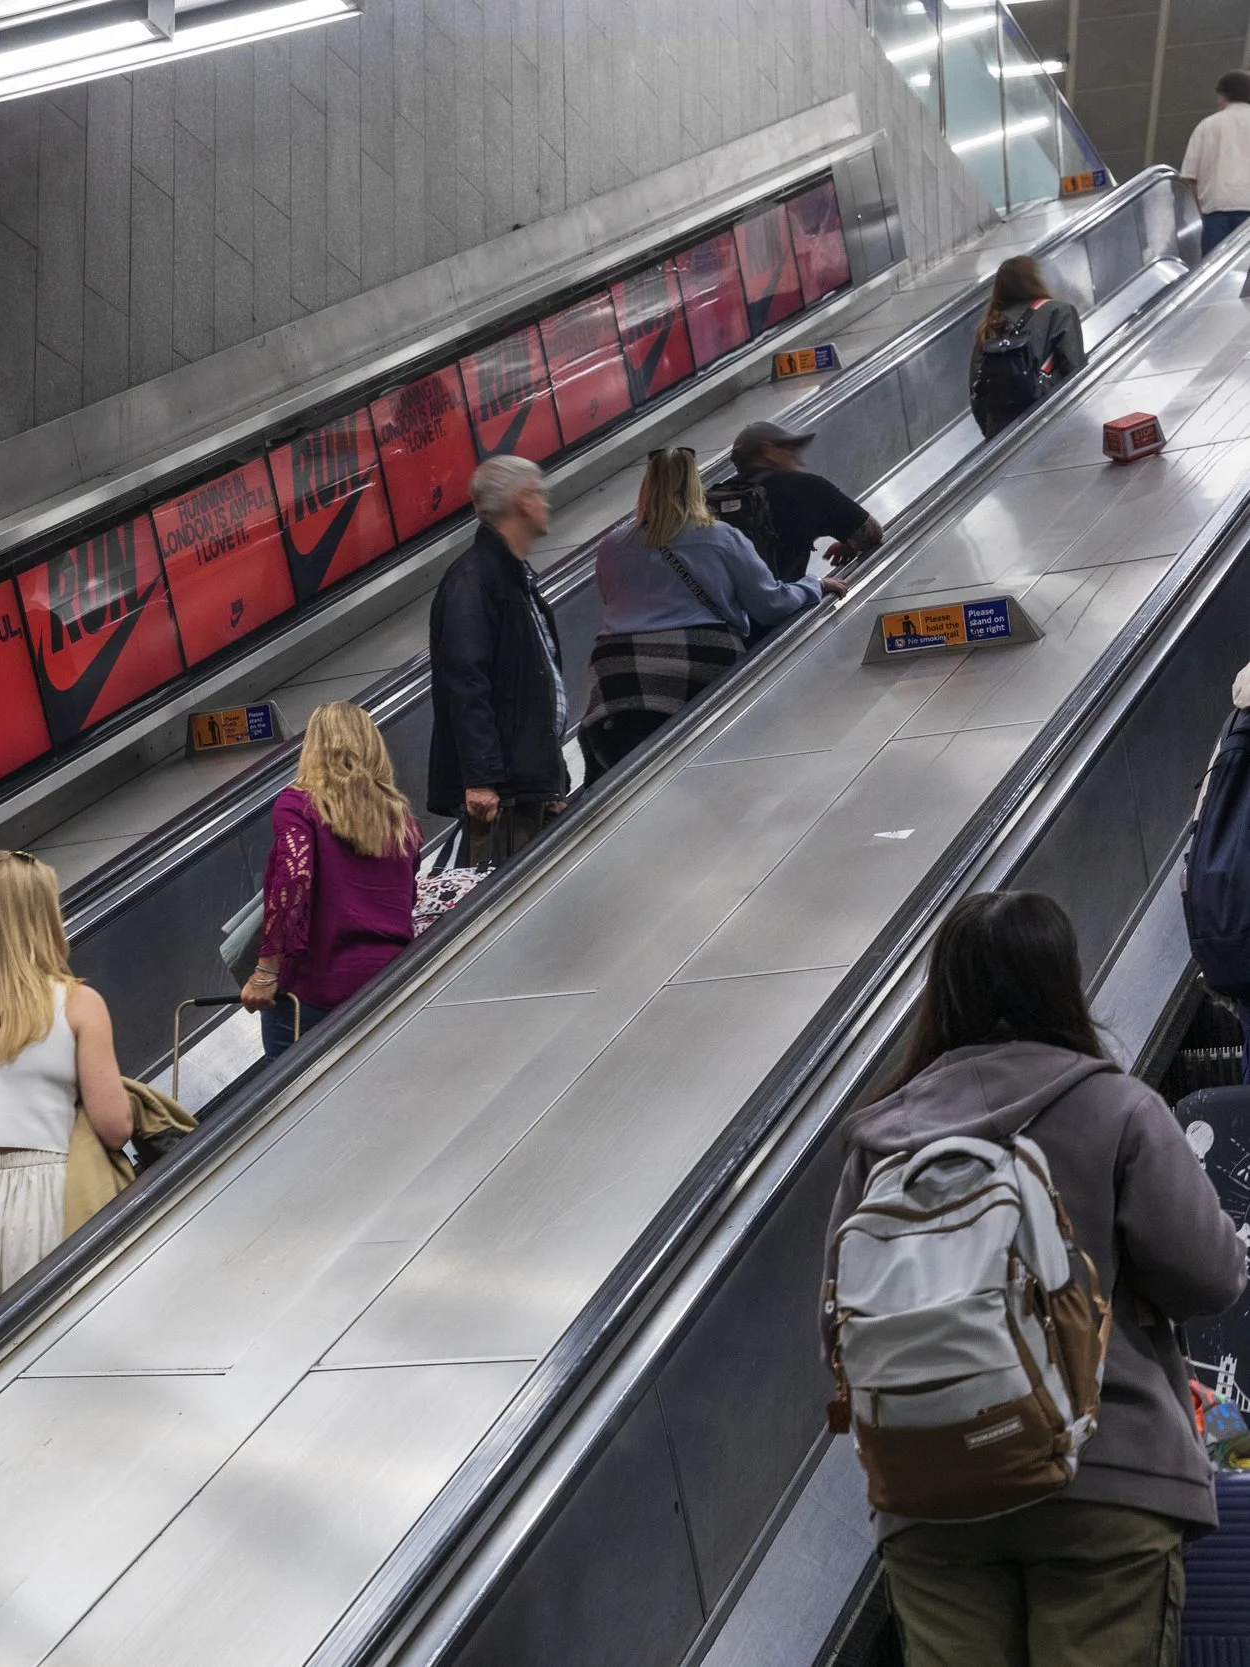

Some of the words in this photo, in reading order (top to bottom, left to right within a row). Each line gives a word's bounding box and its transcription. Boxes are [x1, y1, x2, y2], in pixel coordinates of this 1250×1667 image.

[1134, 427, 1154, 440] STOP
[291, 415, 361, 523] RUN
[177, 478, 232, 524] RUNNING
[231, 472, 247, 497] IN
[159, 513, 213, 558] LONDON
[213, 507, 228, 529] IS
[195, 545, 202, 566] I
[203, 527, 236, 562] LOVE
[235, 521, 249, 545] IT.
[48, 519, 138, 654] RUN
[924, 615, 951, 624] Please
[968, 608, 994, 618] Please
[926, 623, 944, 632] hold
[946, 622, 959, 631] the
[969, 616, 992, 627] stand
[986, 624, 1006, 634] right
